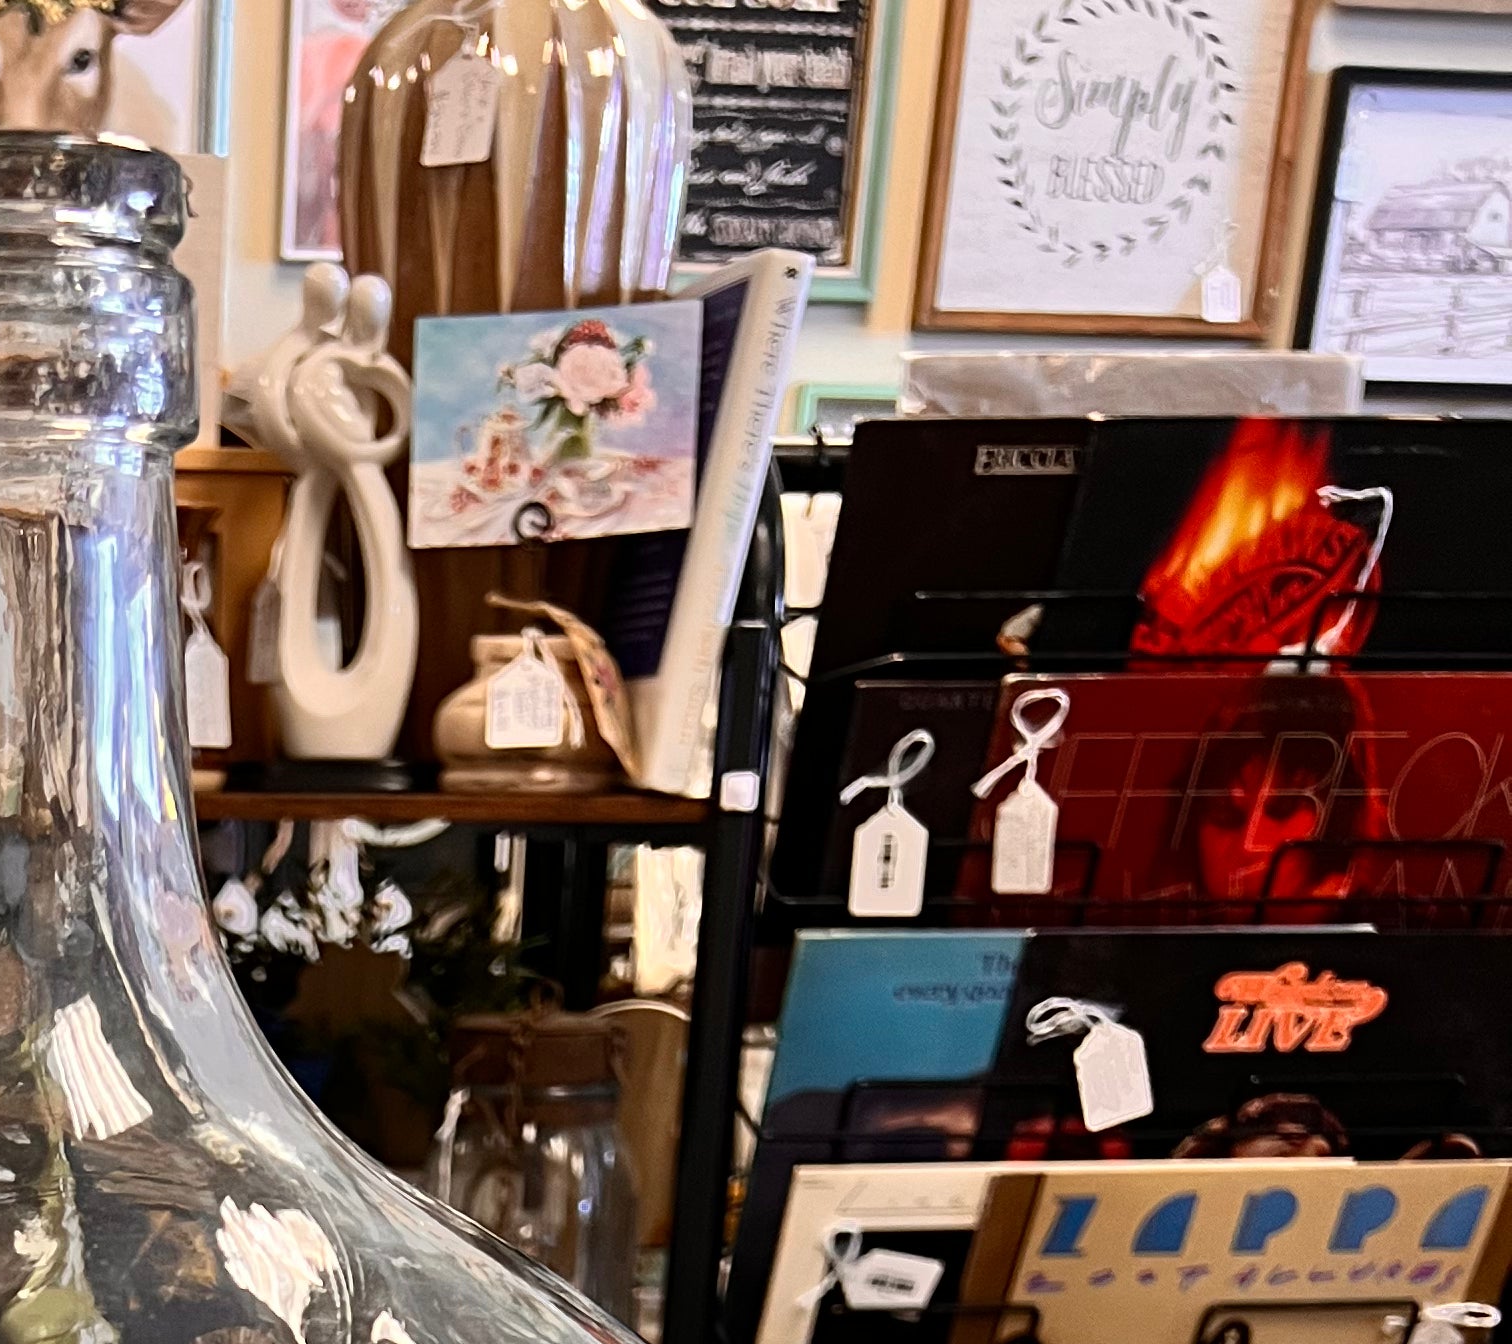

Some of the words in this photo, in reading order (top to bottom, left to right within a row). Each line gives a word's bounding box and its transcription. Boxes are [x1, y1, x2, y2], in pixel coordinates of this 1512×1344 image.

[1035, 50, 1197, 162] Simply
[1046, 154, 1165, 204] BLESSED
[1202, 1004, 1352, 1053] LIVE
[1039, 1185, 1491, 1258] ZAPPA
